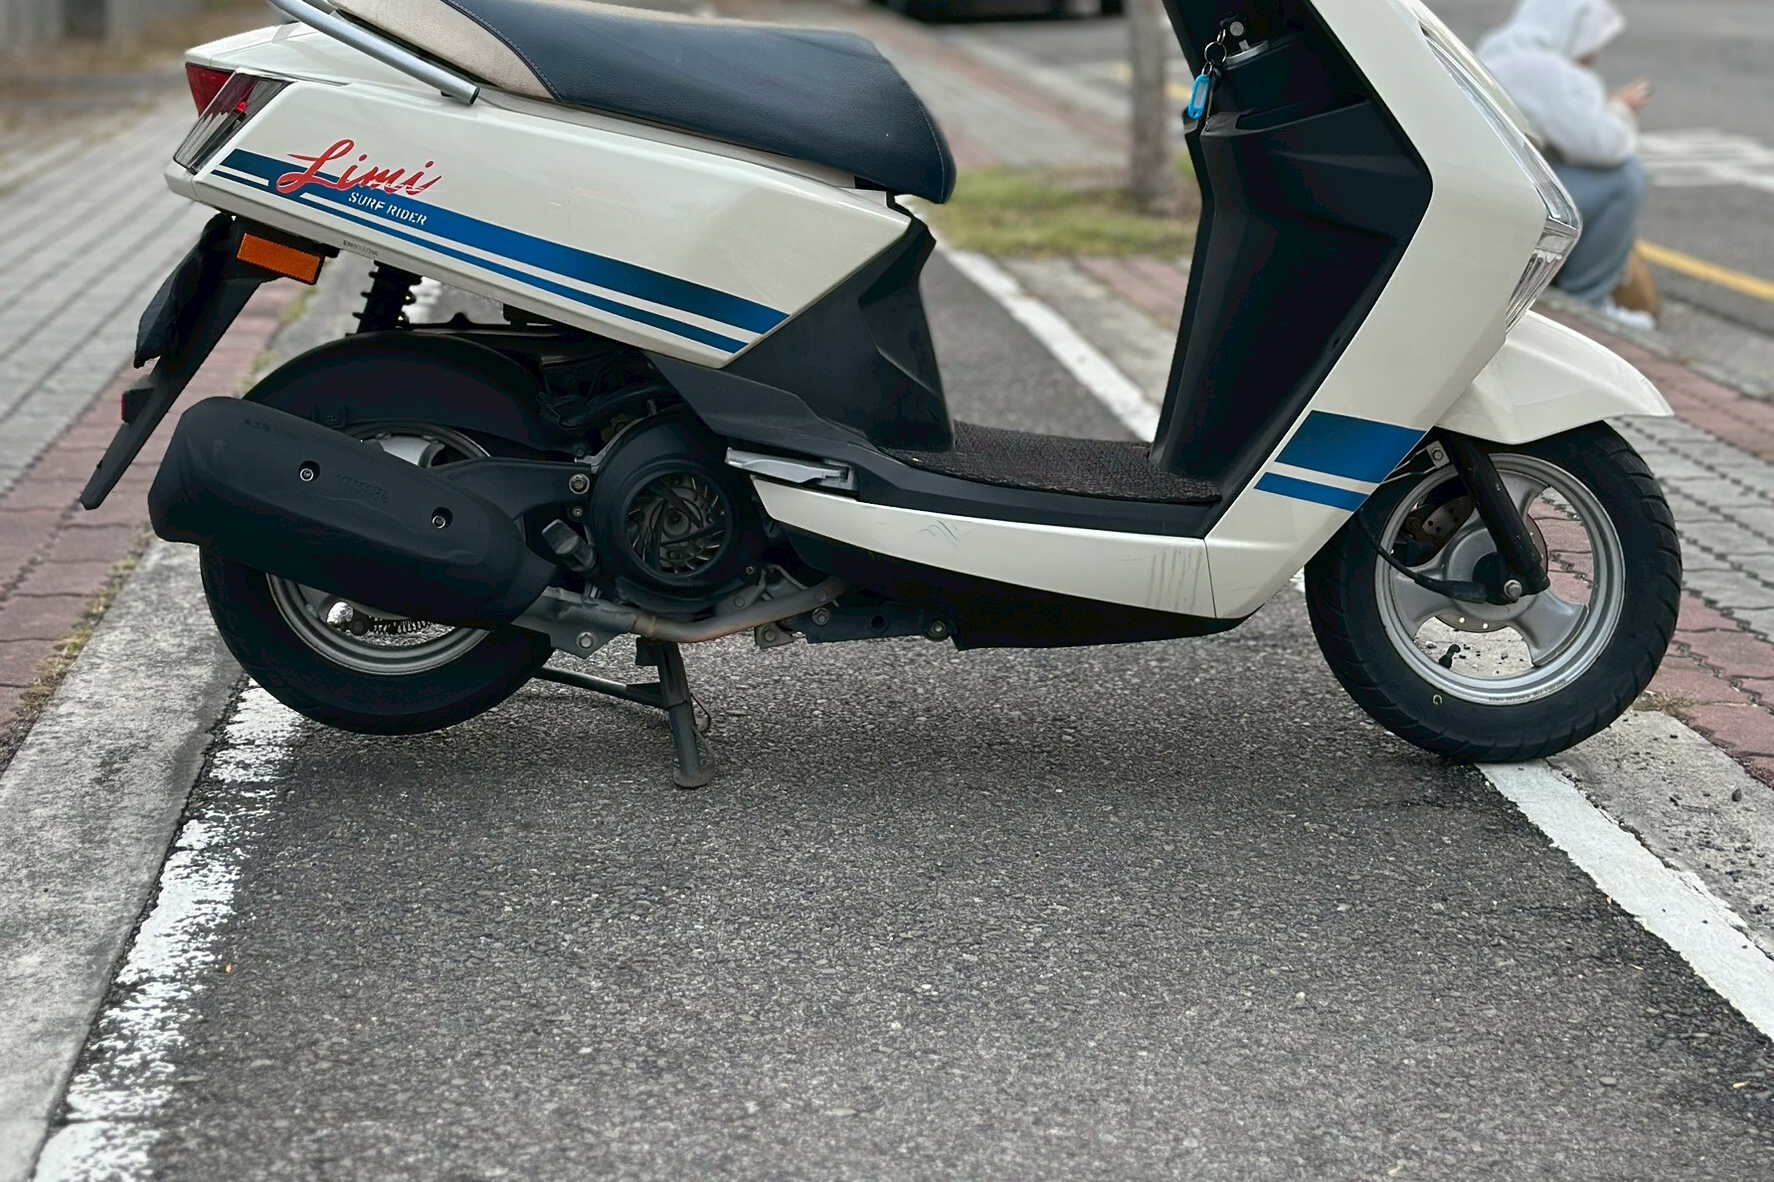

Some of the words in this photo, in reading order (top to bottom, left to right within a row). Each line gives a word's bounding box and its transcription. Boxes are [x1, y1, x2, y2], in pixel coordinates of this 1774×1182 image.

[276, 139, 442, 195] Limi
[348, 191, 384, 211] SURF
[386, 204, 428, 226] RIDER
